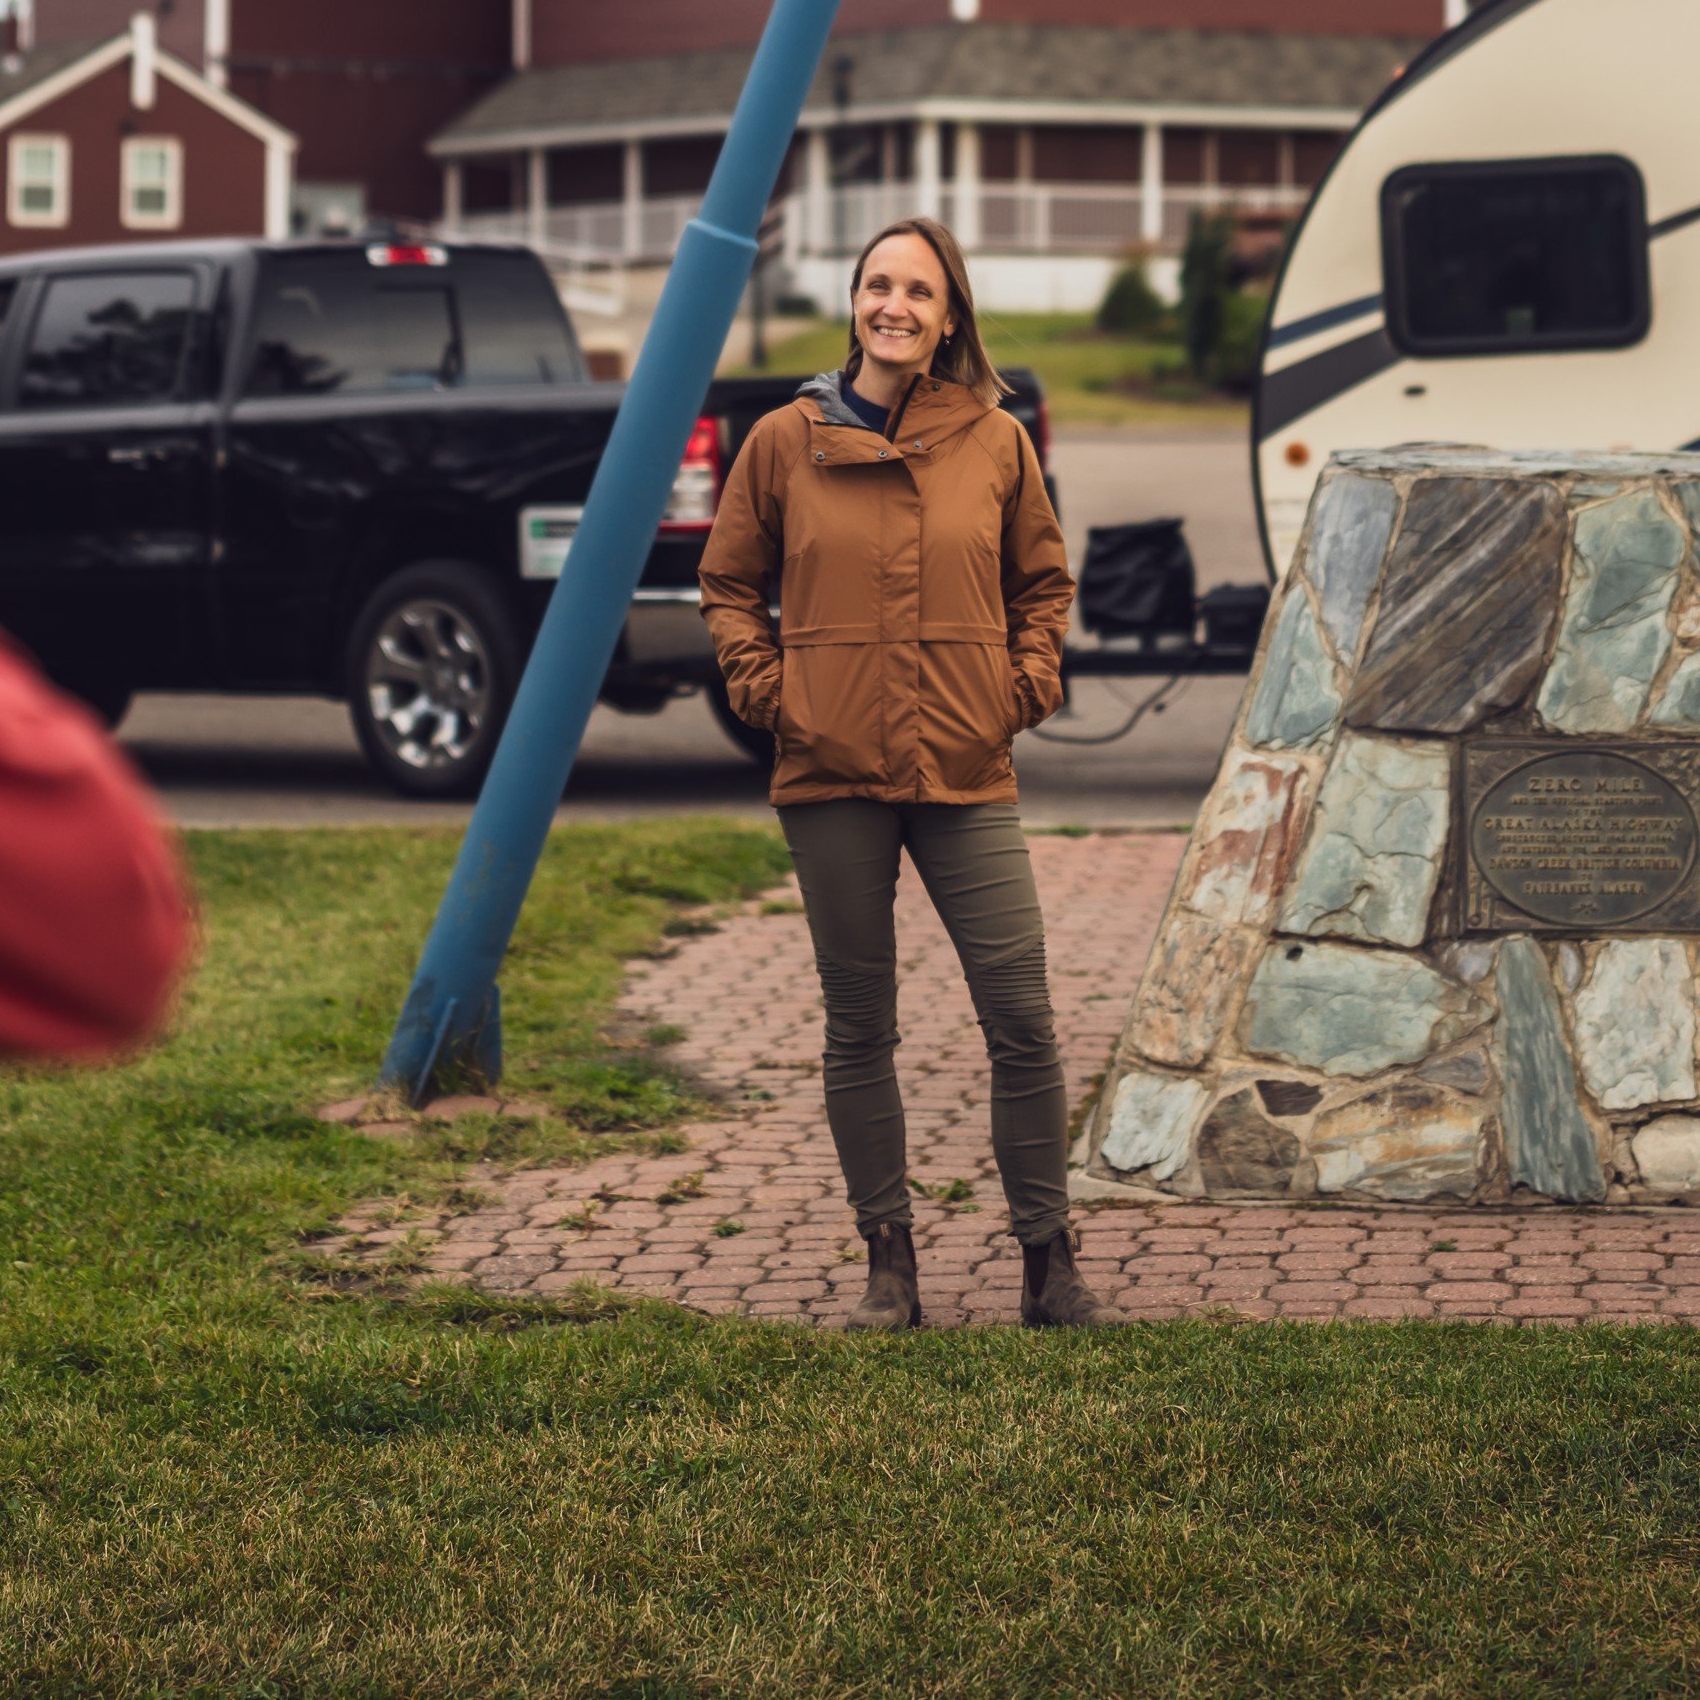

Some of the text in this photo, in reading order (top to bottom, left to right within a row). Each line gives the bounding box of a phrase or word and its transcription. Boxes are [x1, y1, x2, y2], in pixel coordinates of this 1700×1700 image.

[1528, 776, 1645, 792] ZERO MILE
[1484, 817, 1685, 830] GREAT ALASKA HIGHWAY
[1489, 857, 1532, 870] DAWSON
[1576, 857, 1620, 870] BRITISH
[1624, 857, 1680, 870] COLUMBIA
[1600, 882, 1645, 895] ALASKA
